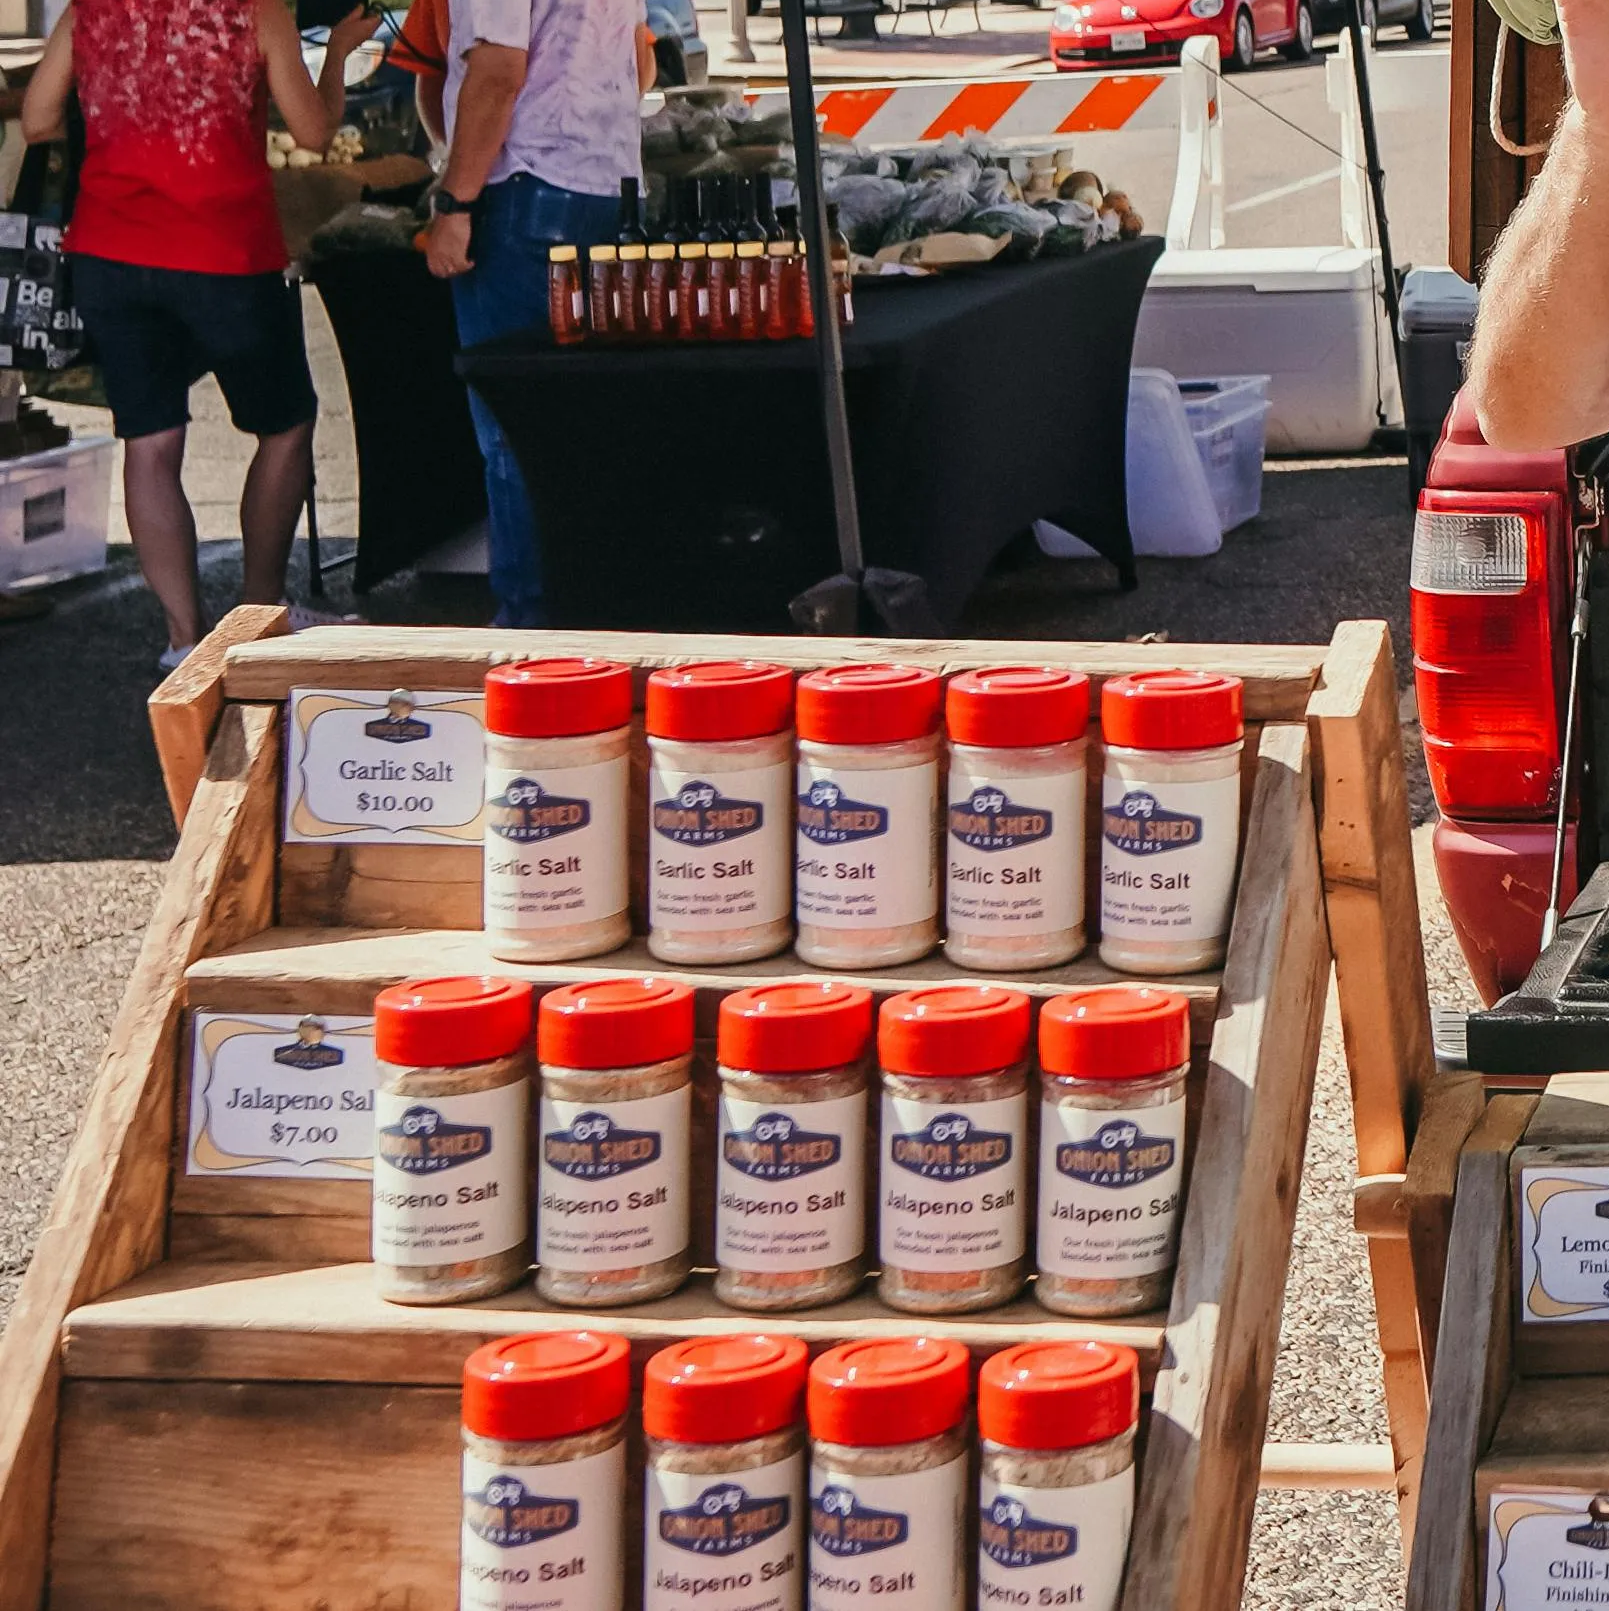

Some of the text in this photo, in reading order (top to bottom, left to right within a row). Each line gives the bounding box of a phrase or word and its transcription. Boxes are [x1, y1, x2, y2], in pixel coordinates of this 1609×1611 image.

[17, 278, 54, 308] Be
[338, 759, 455, 783] Garlic Salt
[355, 791, 434, 815] $10.00
[673, 830, 726, 841] FARMS
[995, 815, 1046, 837] SHED
[1144, 819, 1196, 841] SHED
[1116, 838, 1163, 852] FARMS
[538, 856, 582, 876] Salt
[712, 858, 755, 879] Salt
[834, 861, 877, 880] Salt
[1000, 866, 1042, 885] Salt
[1150, 872, 1191, 890] Salt
[225, 1087, 374, 1114] Jalapeno Sal
[270, 1121, 338, 1146] $7.00
[1060, 1148, 1120, 1173] ONION
[1088, 1171, 1145, 1184] FARMS
[375, 1181, 500, 1210] alapeno Salt
[626, 1185, 669, 1210] Salt
[806, 1189, 847, 1213] Salt
[885, 1188, 1017, 1219] Jalapeno Salt
[1048, 1198, 1144, 1228] Jalapeno
[844, 1517, 900, 1542] SHED
[538, 1556, 586, 1582] Salt
[655, 1567, 753, 1599] Jalapeno
[869, 1570, 917, 1595] Salt
[1038, 1580, 1086, 1607] Salt
